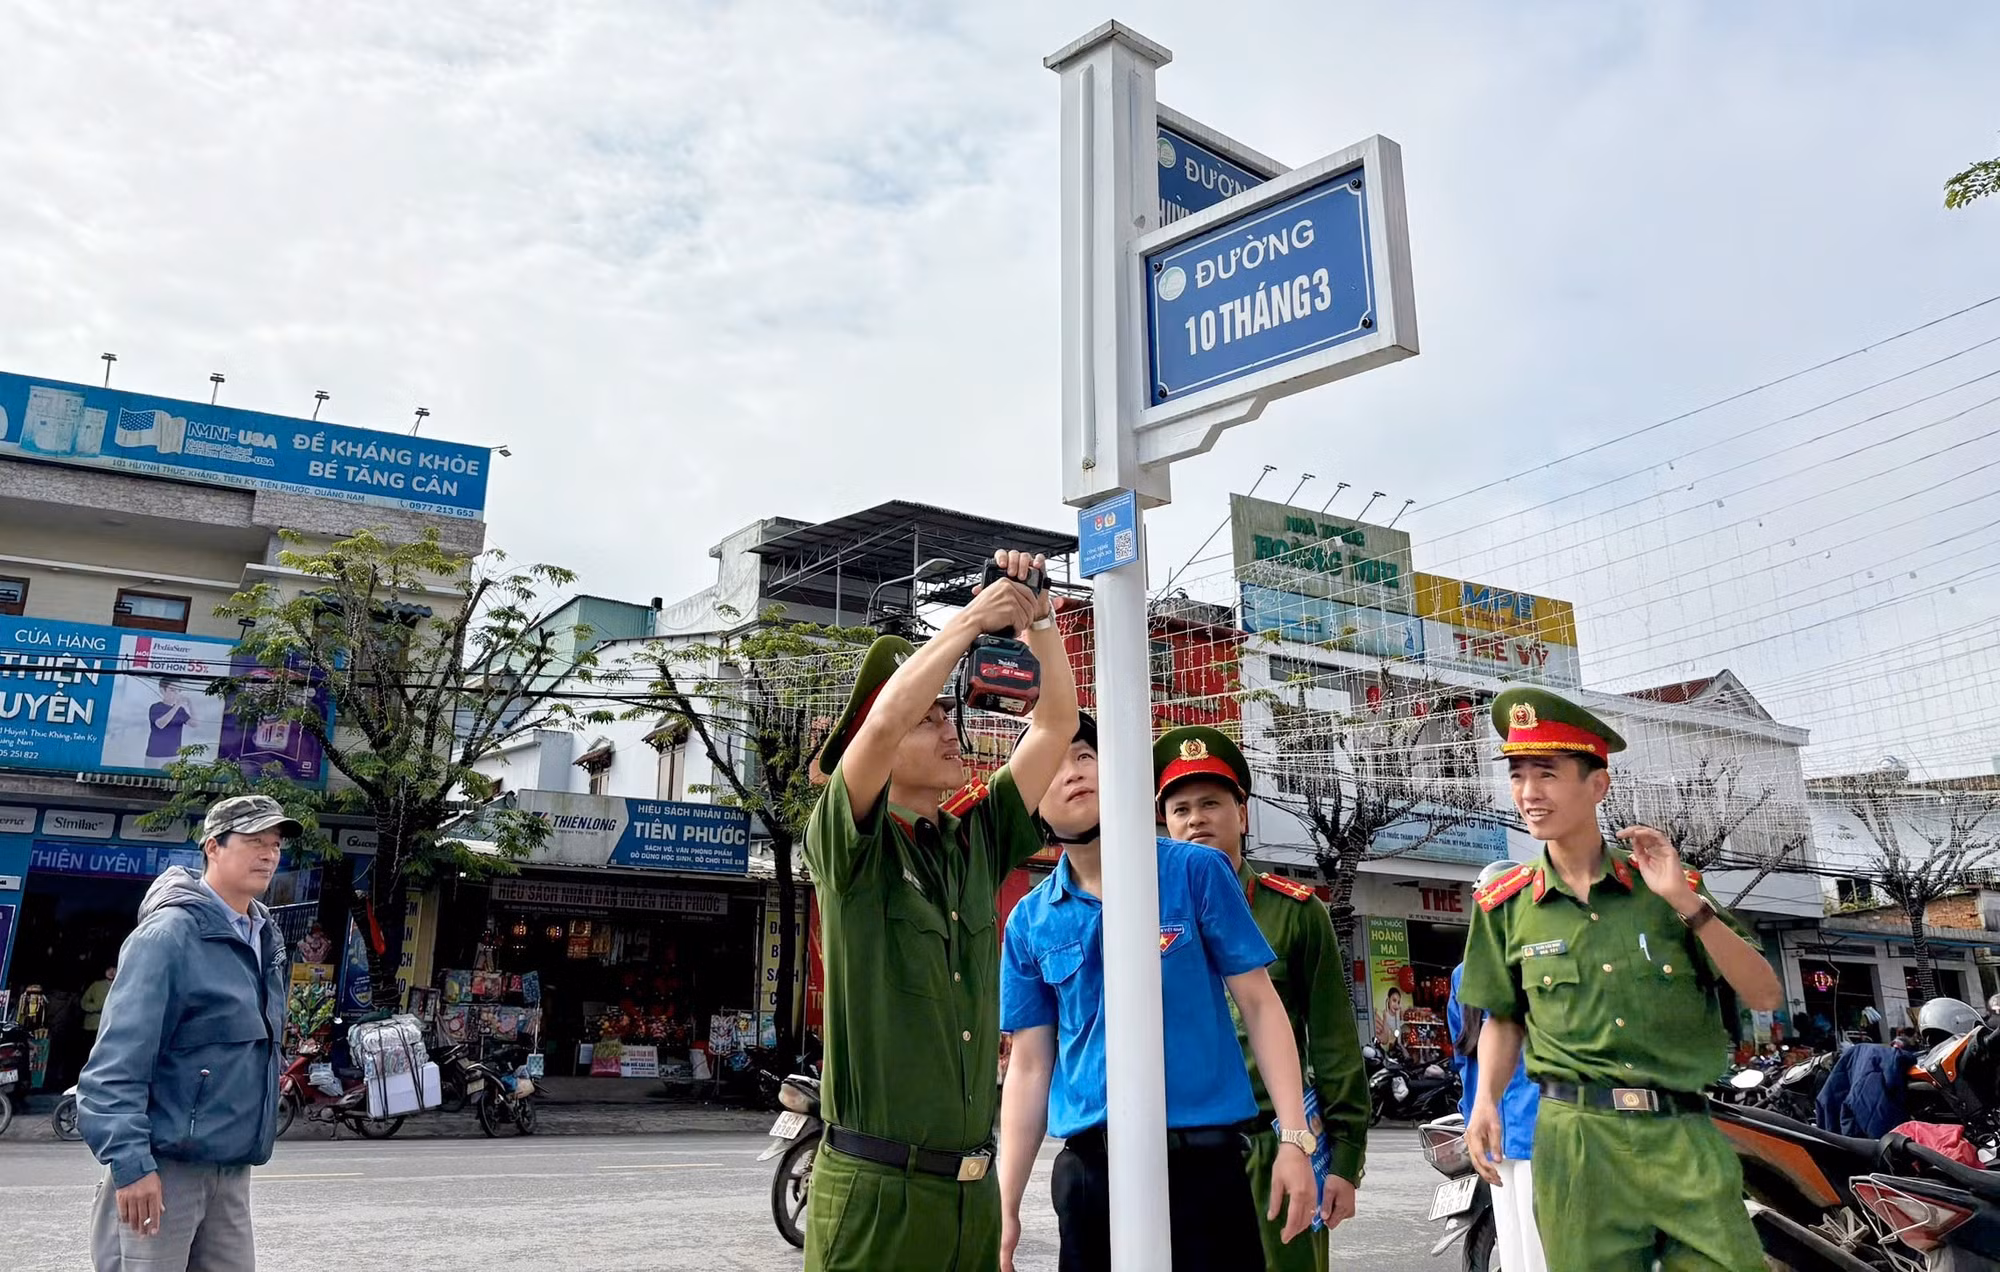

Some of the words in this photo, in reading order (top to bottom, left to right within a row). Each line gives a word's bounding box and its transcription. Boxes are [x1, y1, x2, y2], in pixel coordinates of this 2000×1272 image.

[1185, 157, 1248, 198] ĐƯỜN
[1195, 219, 1316, 289] ĐƯỜNG
[292, 431, 325, 453] ĐỀ
[330, 440, 412, 466] KHÁNG
[418, 453, 480, 476] KHỎE
[308, 459, 338, 479] BÉ
[344, 463, 404, 489] TĂNG
[412, 474, 458, 497] CÂN
[346, 493, 365, 502] NAM
[409, 501, 432, 512] 0977
[436, 505, 454, 514] 213
[15, 627, 52, 646] CỬA
[57, 632, 107, 650] HÀNG
[0, 651, 102, 688] THIỆN
[0, 691, 94, 725] UYÊN
[54, 816, 98, 831] Similac
[638, 803, 661, 816] HIỆU
[664, 805, 690, 817] SÁCH
[693, 807, 720, 819] NHÂN
[634, 818, 676, 840] TIÊN
[683, 824, 746, 846] PHƯỚC
[30, 848, 83, 871] THIỆN
[90, 852, 141, 873] UYÊN
[1371, 928, 1404, 942] HOÀNG
[1381, 944, 1398, 955] MAI
